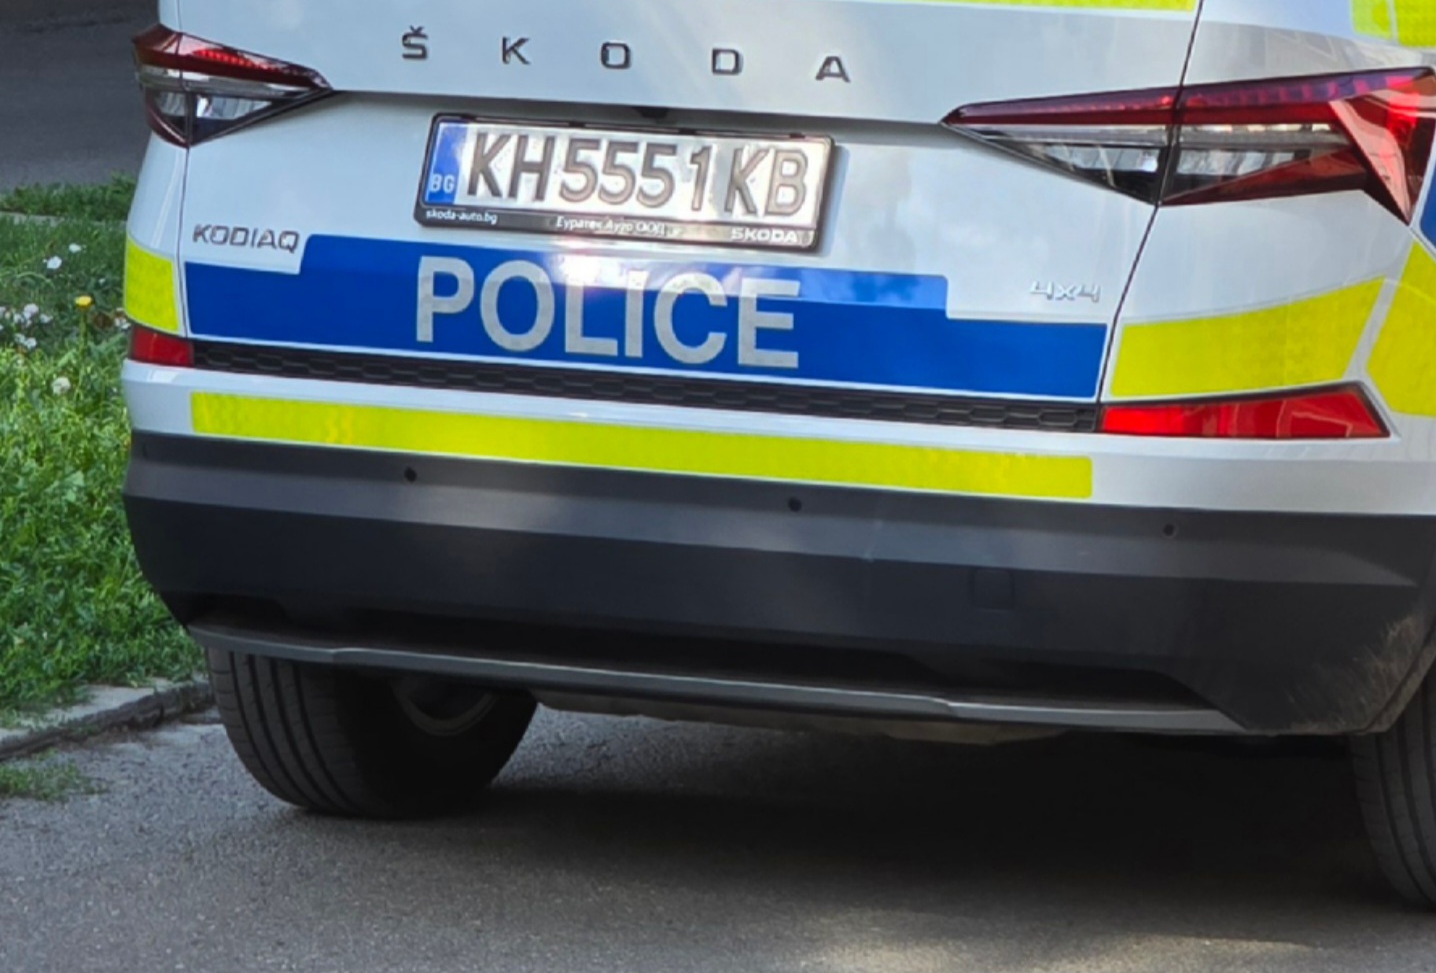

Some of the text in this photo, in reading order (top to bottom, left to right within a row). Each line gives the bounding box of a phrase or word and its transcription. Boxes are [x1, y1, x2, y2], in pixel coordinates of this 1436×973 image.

[430, 173, 455, 195] BG
[426, 208, 498, 226] skoda-auto.bg
[192, 224, 300, 253] KODIAQ
[1030, 280, 1100, 303] 4x4
[415, 255, 801, 369] POLICE
